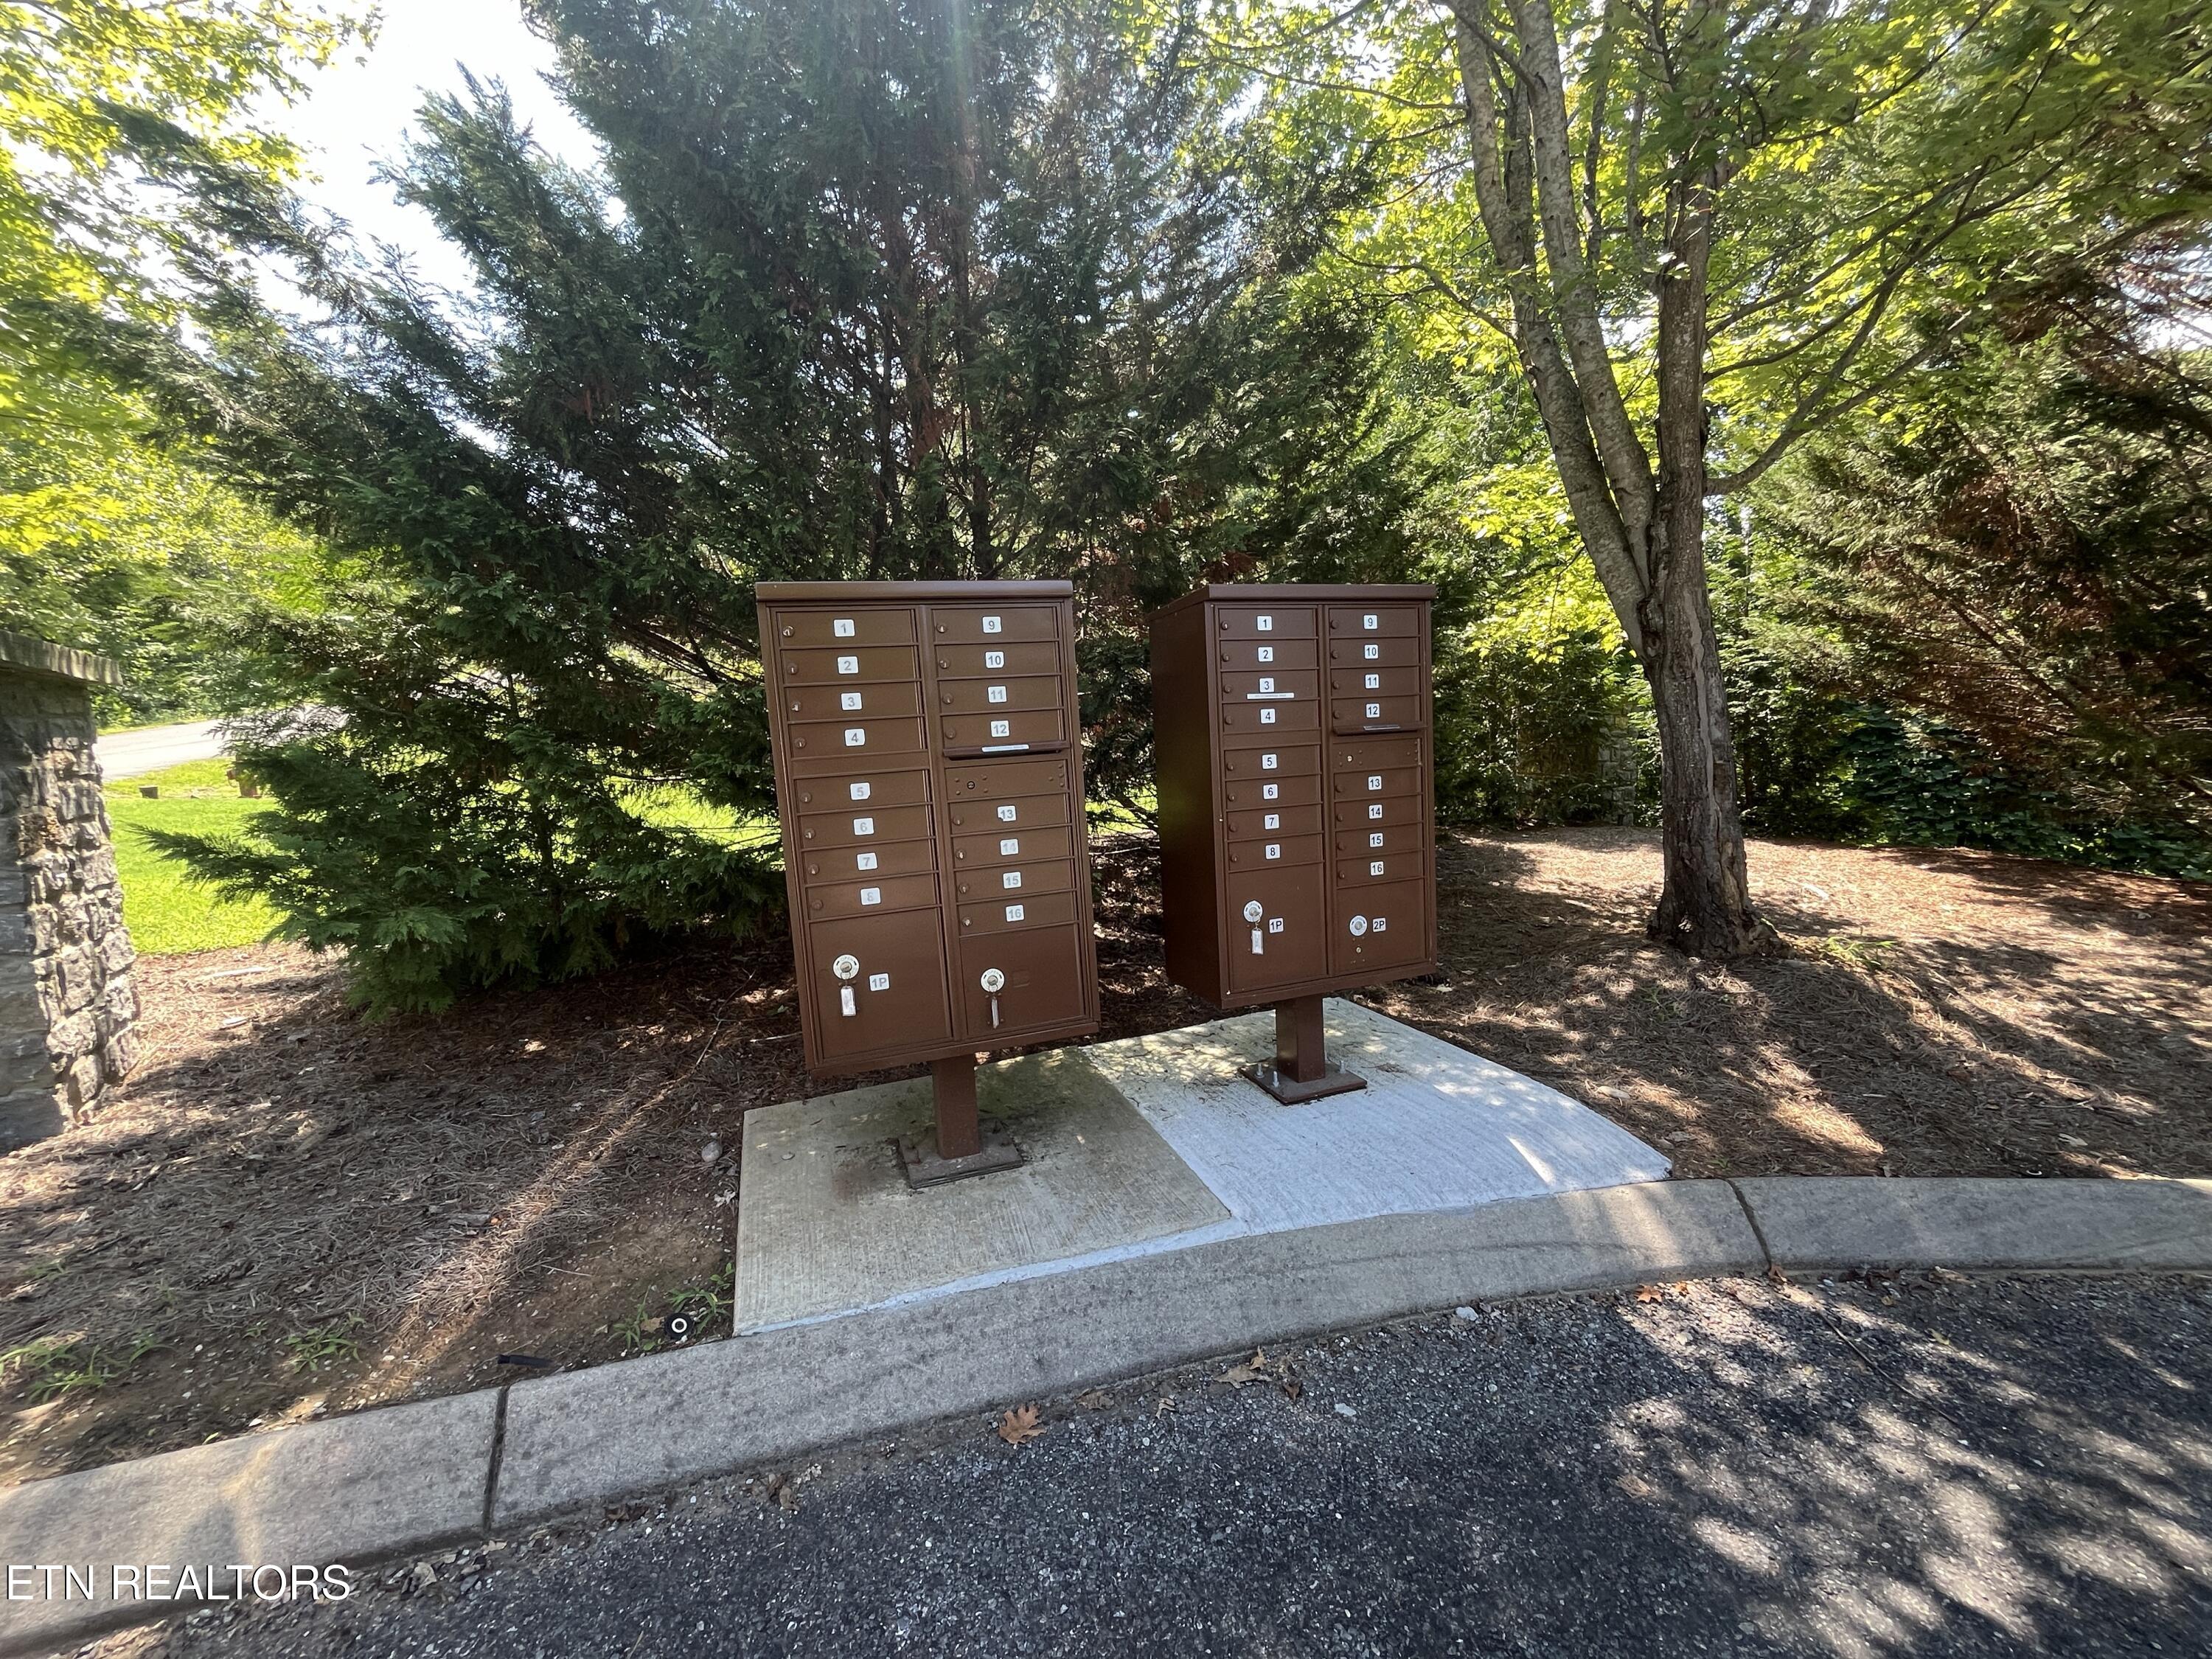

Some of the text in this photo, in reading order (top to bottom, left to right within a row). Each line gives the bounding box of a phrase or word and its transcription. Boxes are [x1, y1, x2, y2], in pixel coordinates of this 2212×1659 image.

[988, 620, 995, 630] 9
[1262, 619, 1267, 628] 1
[1368, 617, 1373, 627] 9
[841, 623, 846, 633] 1
[1263, 650, 1269, 659] 2
[1367, 647, 1377, 656] 10
[988, 655, 1001, 665] 10
[844, 660, 852, 671] 2
[1264, 681, 1270, 690] 3
[1368, 677, 1377, 686] 11
[990, 689, 1004, 700] 11
[847, 696, 855, 707] 3
[1368, 706, 1378, 715] 12
[1265, 712, 1271, 720] 4
[993, 724, 1007, 734] 12
[851, 732, 858, 743] 4
[1267, 757, 1273, 767] 5
[1370, 778, 1380, 788] 13
[857, 786, 864, 797] 5
[1267, 787, 1273, 796] 6
[1001, 809, 1014, 819] 13
[1371, 807, 1380, 817] 14
[860, 821, 868, 832] 6
[1269, 817, 1275, 827] 7
[1371, 835, 1381, 845] 15
[1270, 846, 1276, 857] 8
[863, 857, 871, 867] 7
[1372, 863, 1382, 873] 16
[1006, 875, 1019, 886] 15
[1008, 908, 1022, 919] 16
[1271, 920, 1281, 931] 1P
[1374, 920, 1384, 930] 2P
[872, 977, 887, 988] 1P
